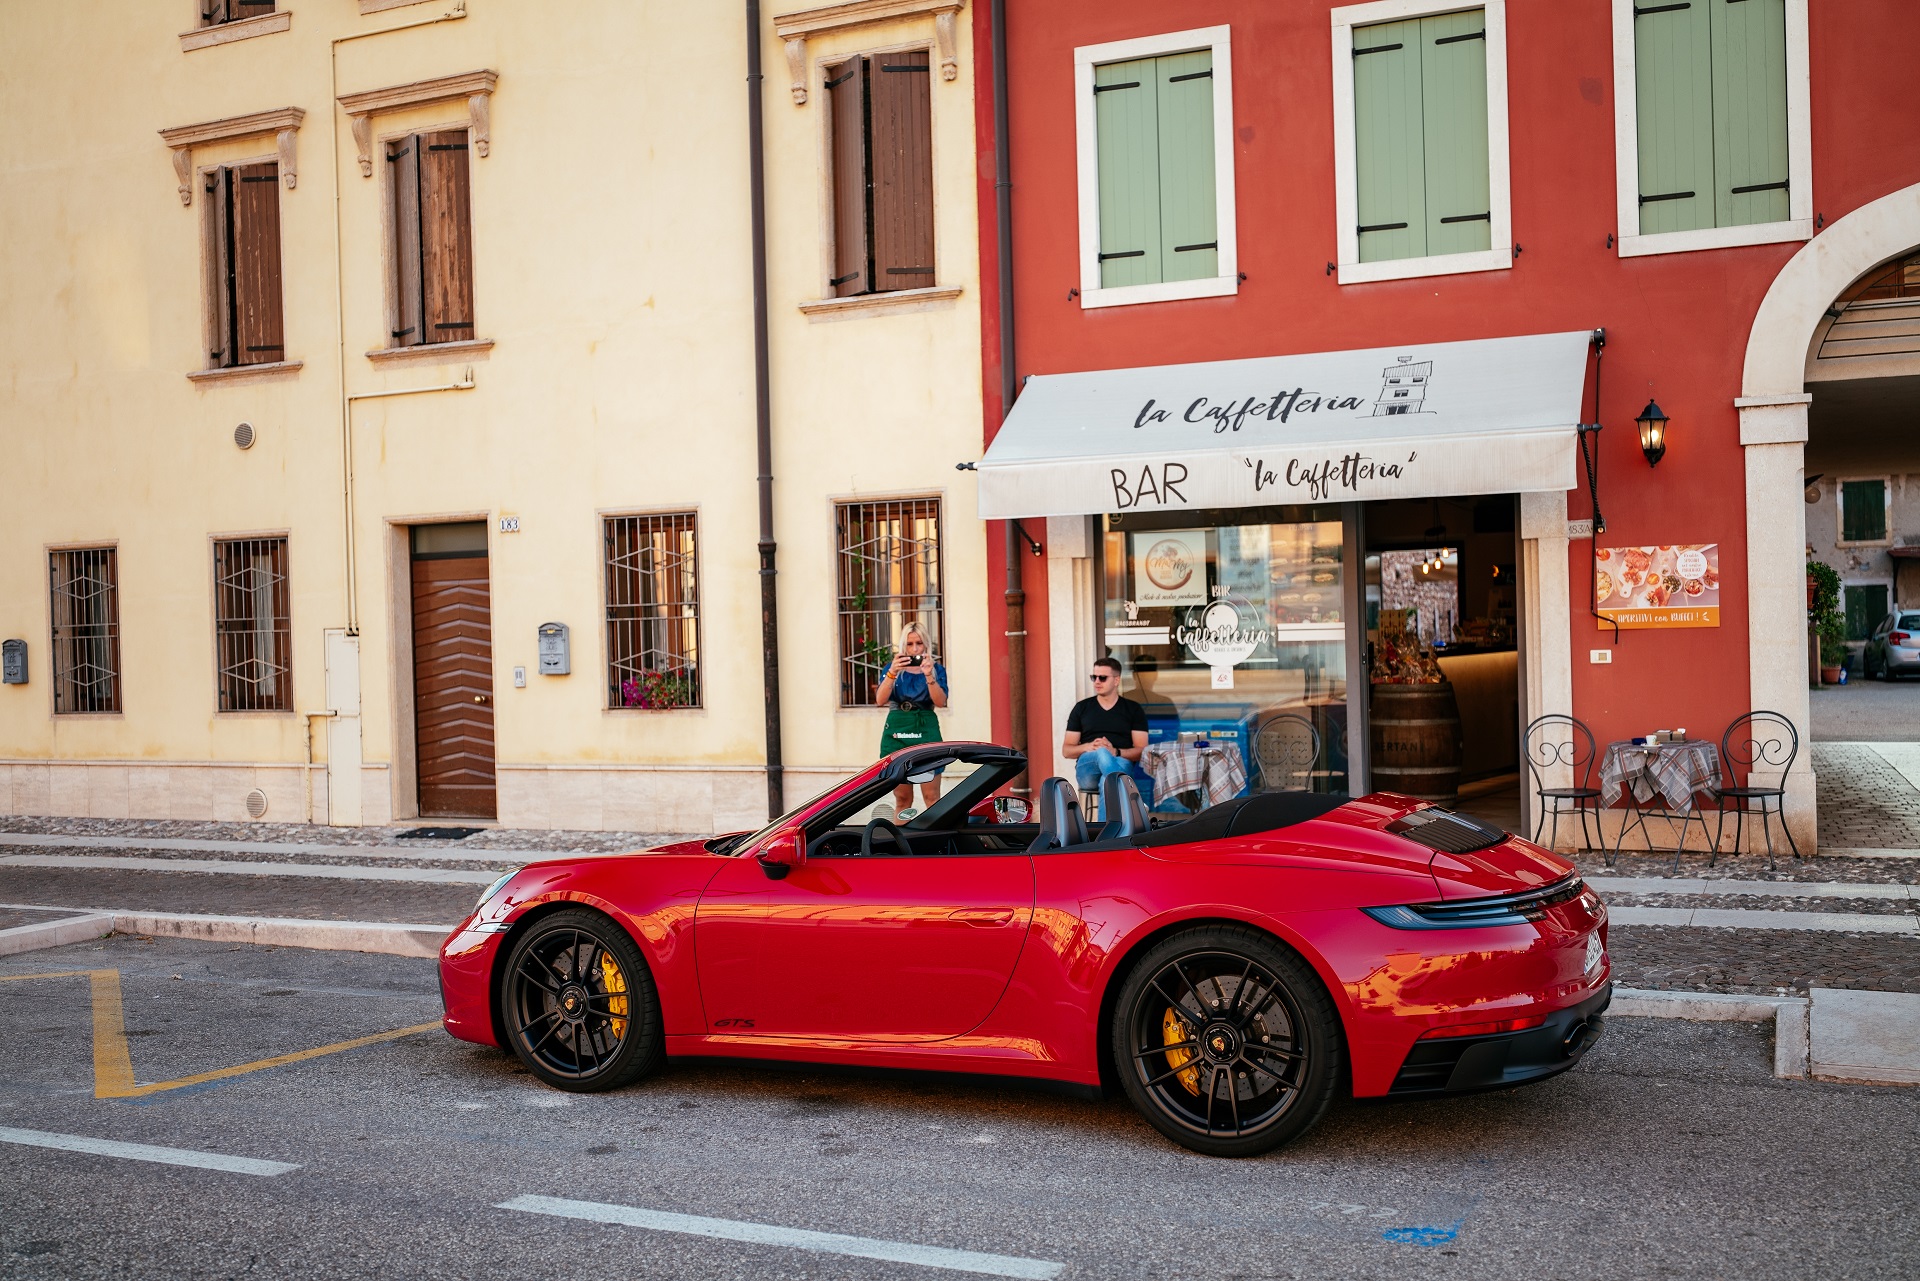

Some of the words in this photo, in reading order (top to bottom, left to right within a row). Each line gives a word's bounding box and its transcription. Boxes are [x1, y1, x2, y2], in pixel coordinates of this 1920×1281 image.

[1183, 387, 1365, 433] Caffetteria
[1110, 462, 1188, 509] BAR
[501, 518, 518, 530] 183
[1176, 624, 1270, 653] Caffetteria
[714, 1018, 755, 1028] GTS
